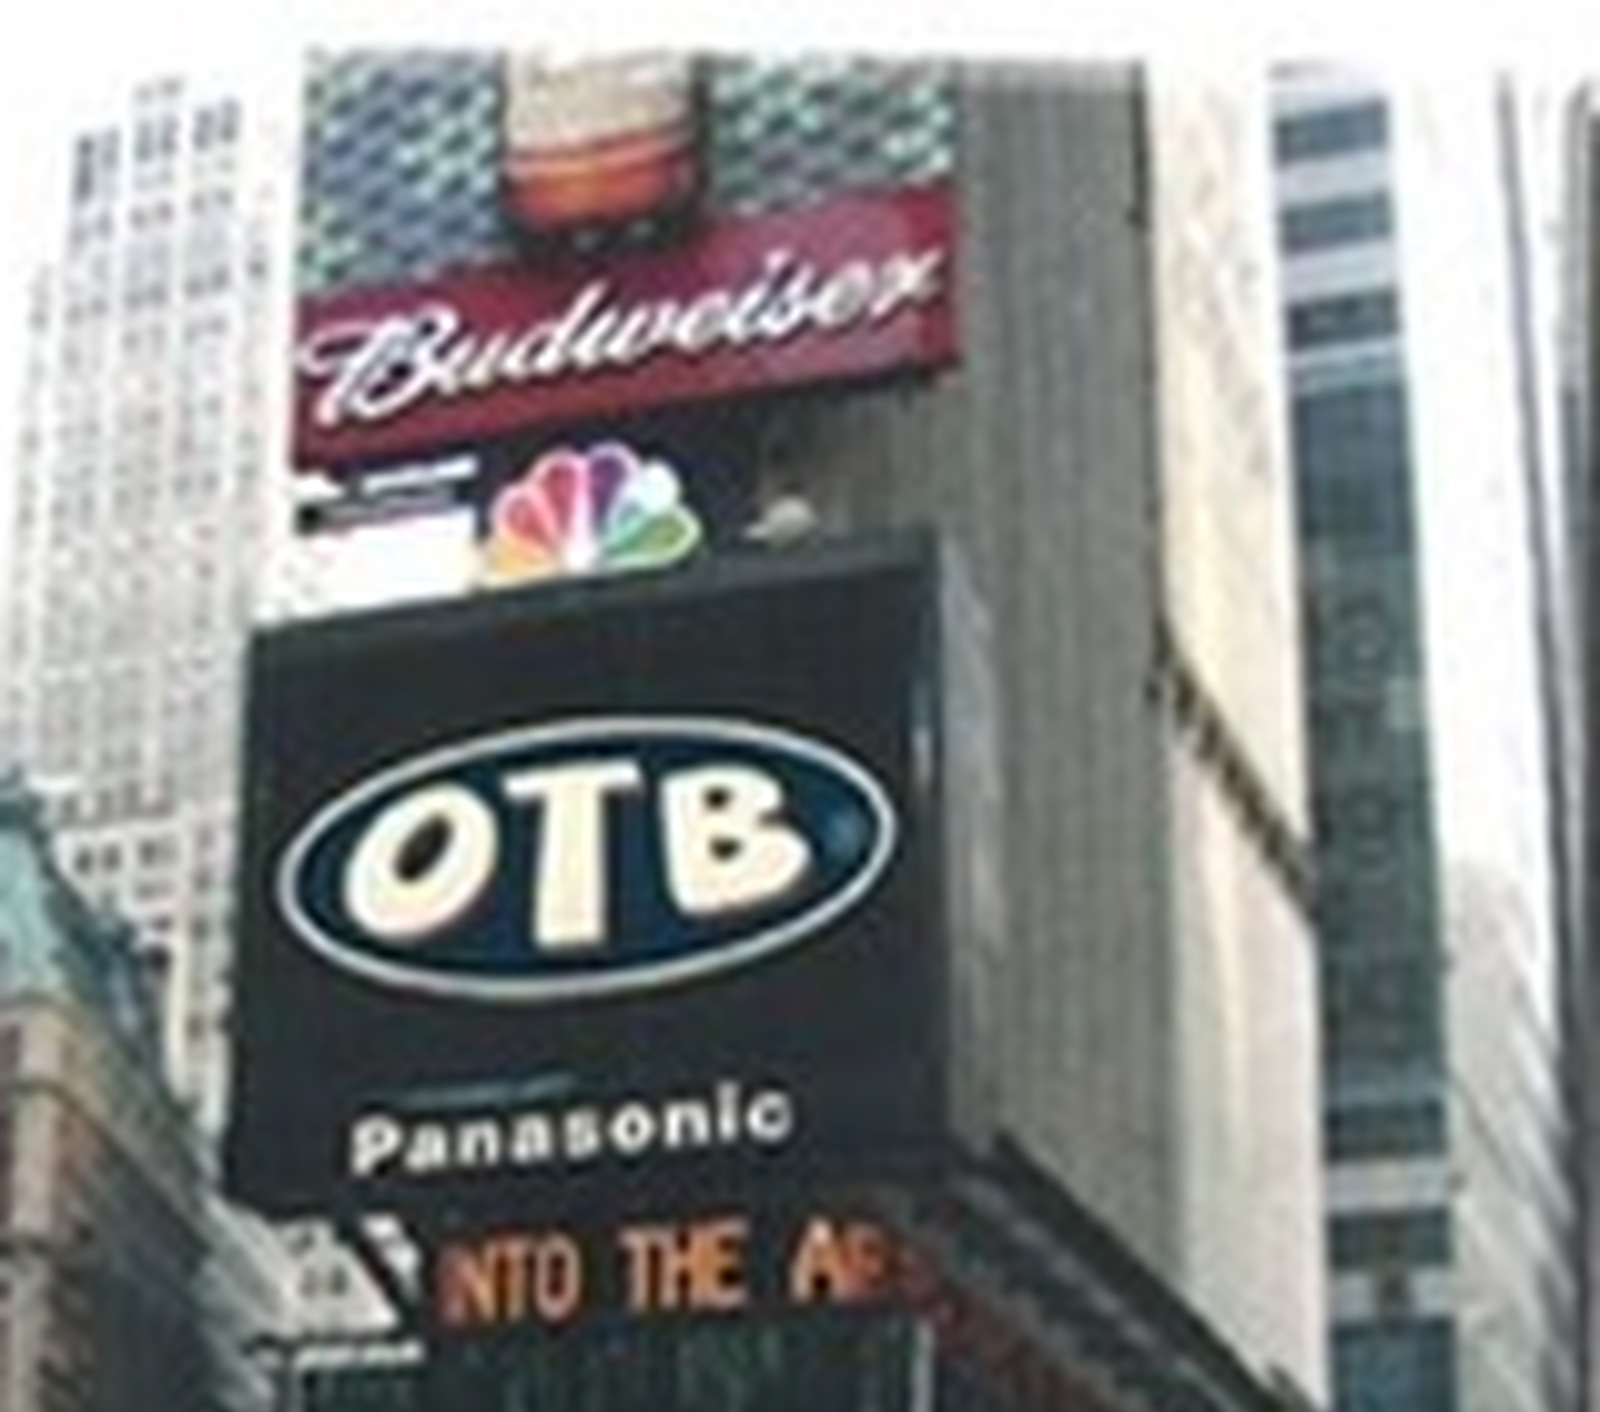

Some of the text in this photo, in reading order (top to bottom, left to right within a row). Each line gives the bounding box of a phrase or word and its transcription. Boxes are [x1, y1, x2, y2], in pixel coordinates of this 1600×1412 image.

[297, 248, 946, 426] Budweiser
[345, 758, 812, 950] OTB
[350, 1084, 792, 1173] Panasonic
[620, 1218, 750, 1309] THE
